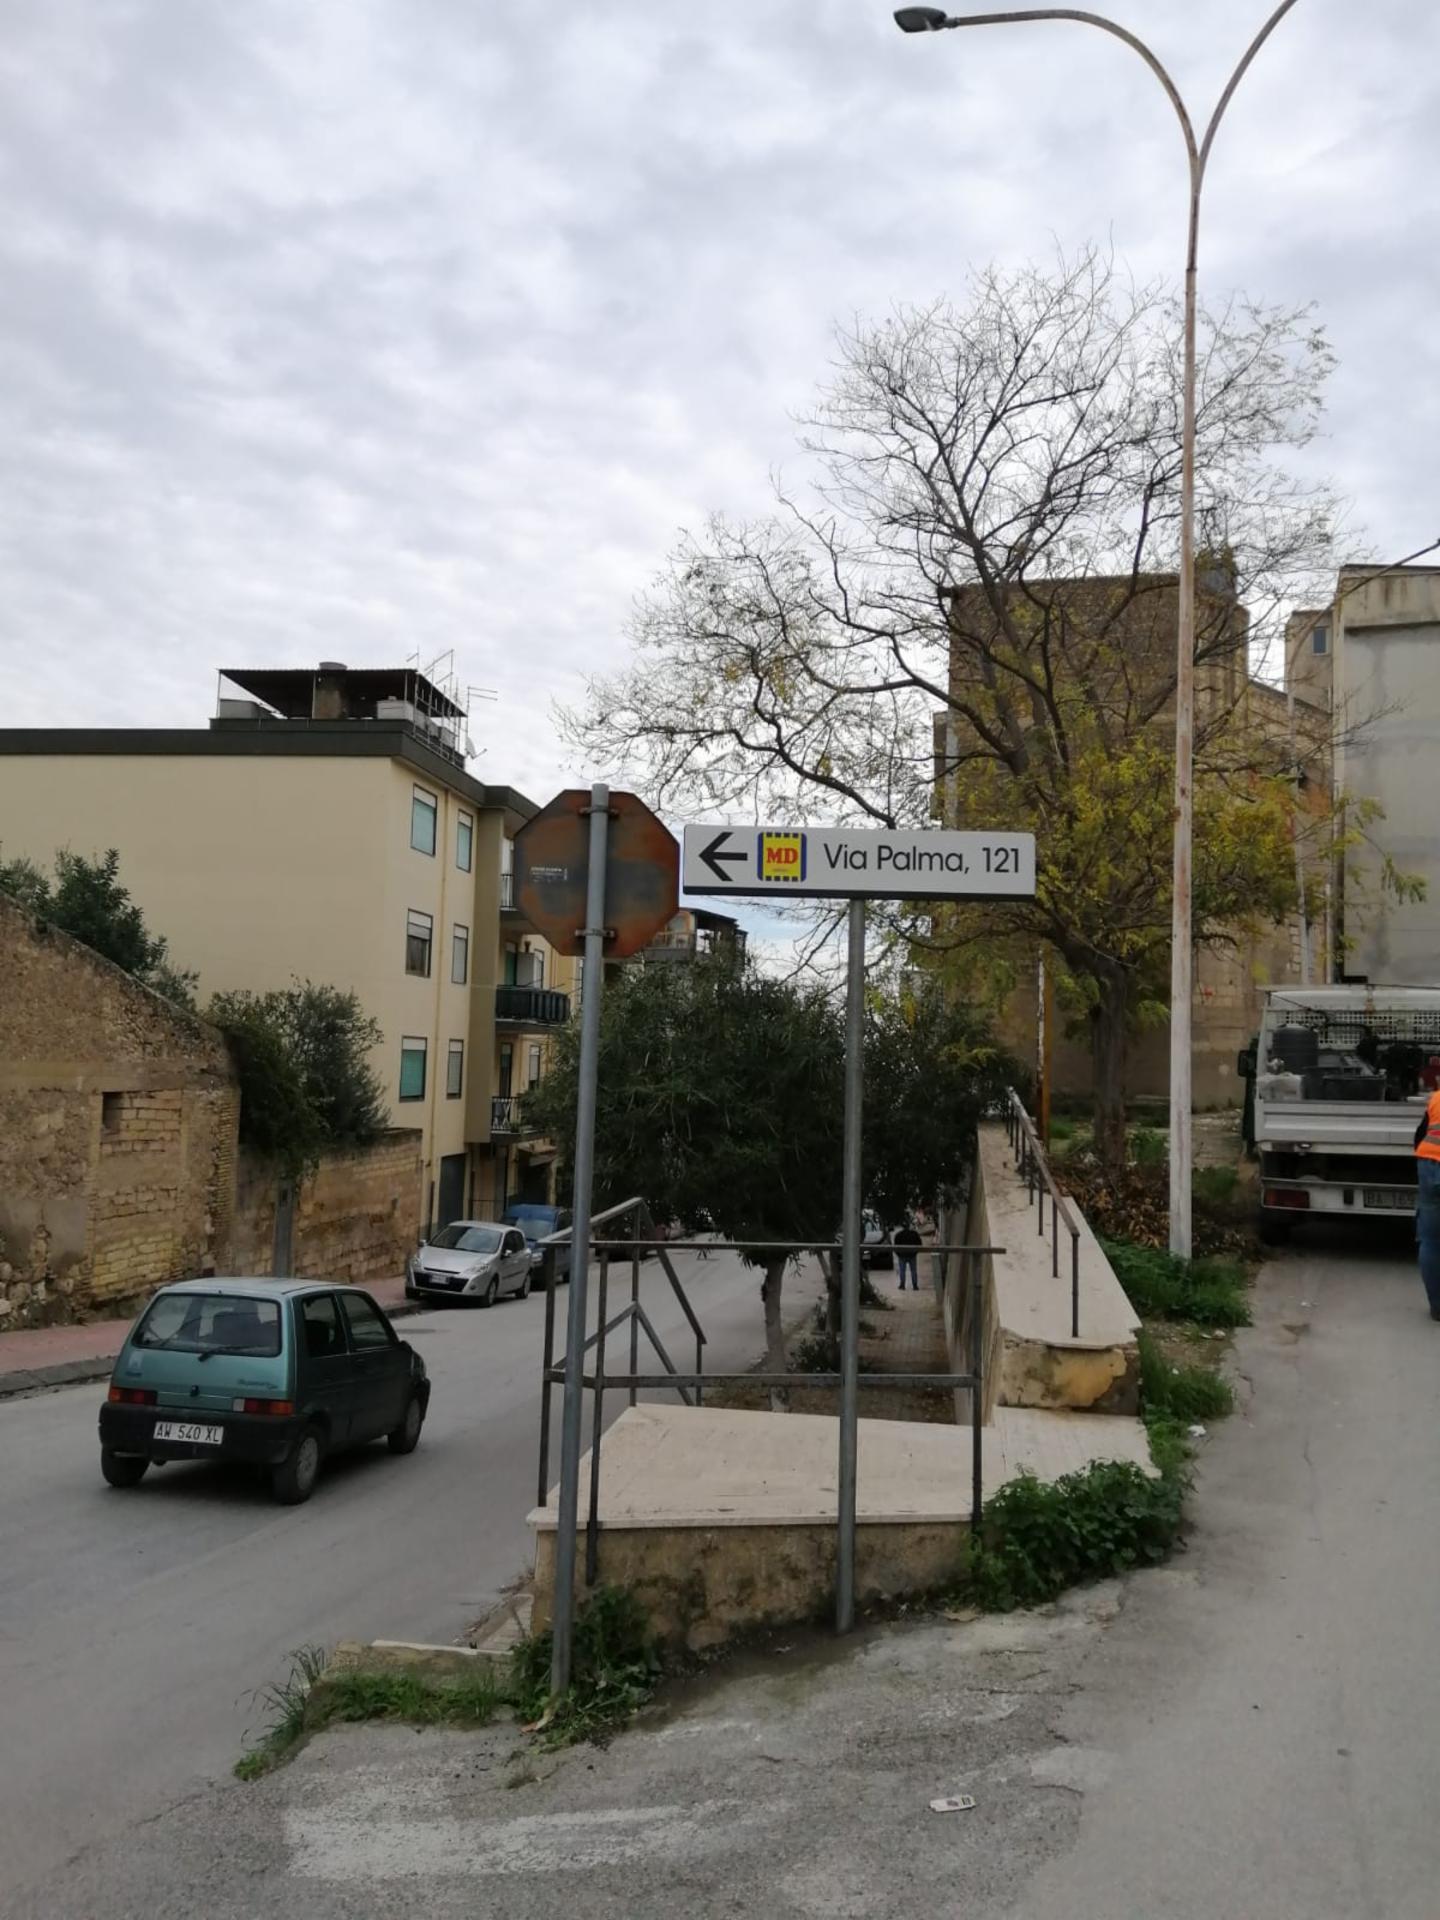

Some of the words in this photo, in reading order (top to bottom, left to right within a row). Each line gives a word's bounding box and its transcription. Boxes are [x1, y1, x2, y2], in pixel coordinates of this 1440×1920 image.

[766, 847, 799, 864] MD
[823, 843, 867, 871] Via
[877, 845, 970, 875] Palma,
[982, 847, 1020, 873] 121
[156, 1423, 173, 1438] AW
[177, 1424, 201, 1441] 540
[205, 1426, 220, 1442] XL
